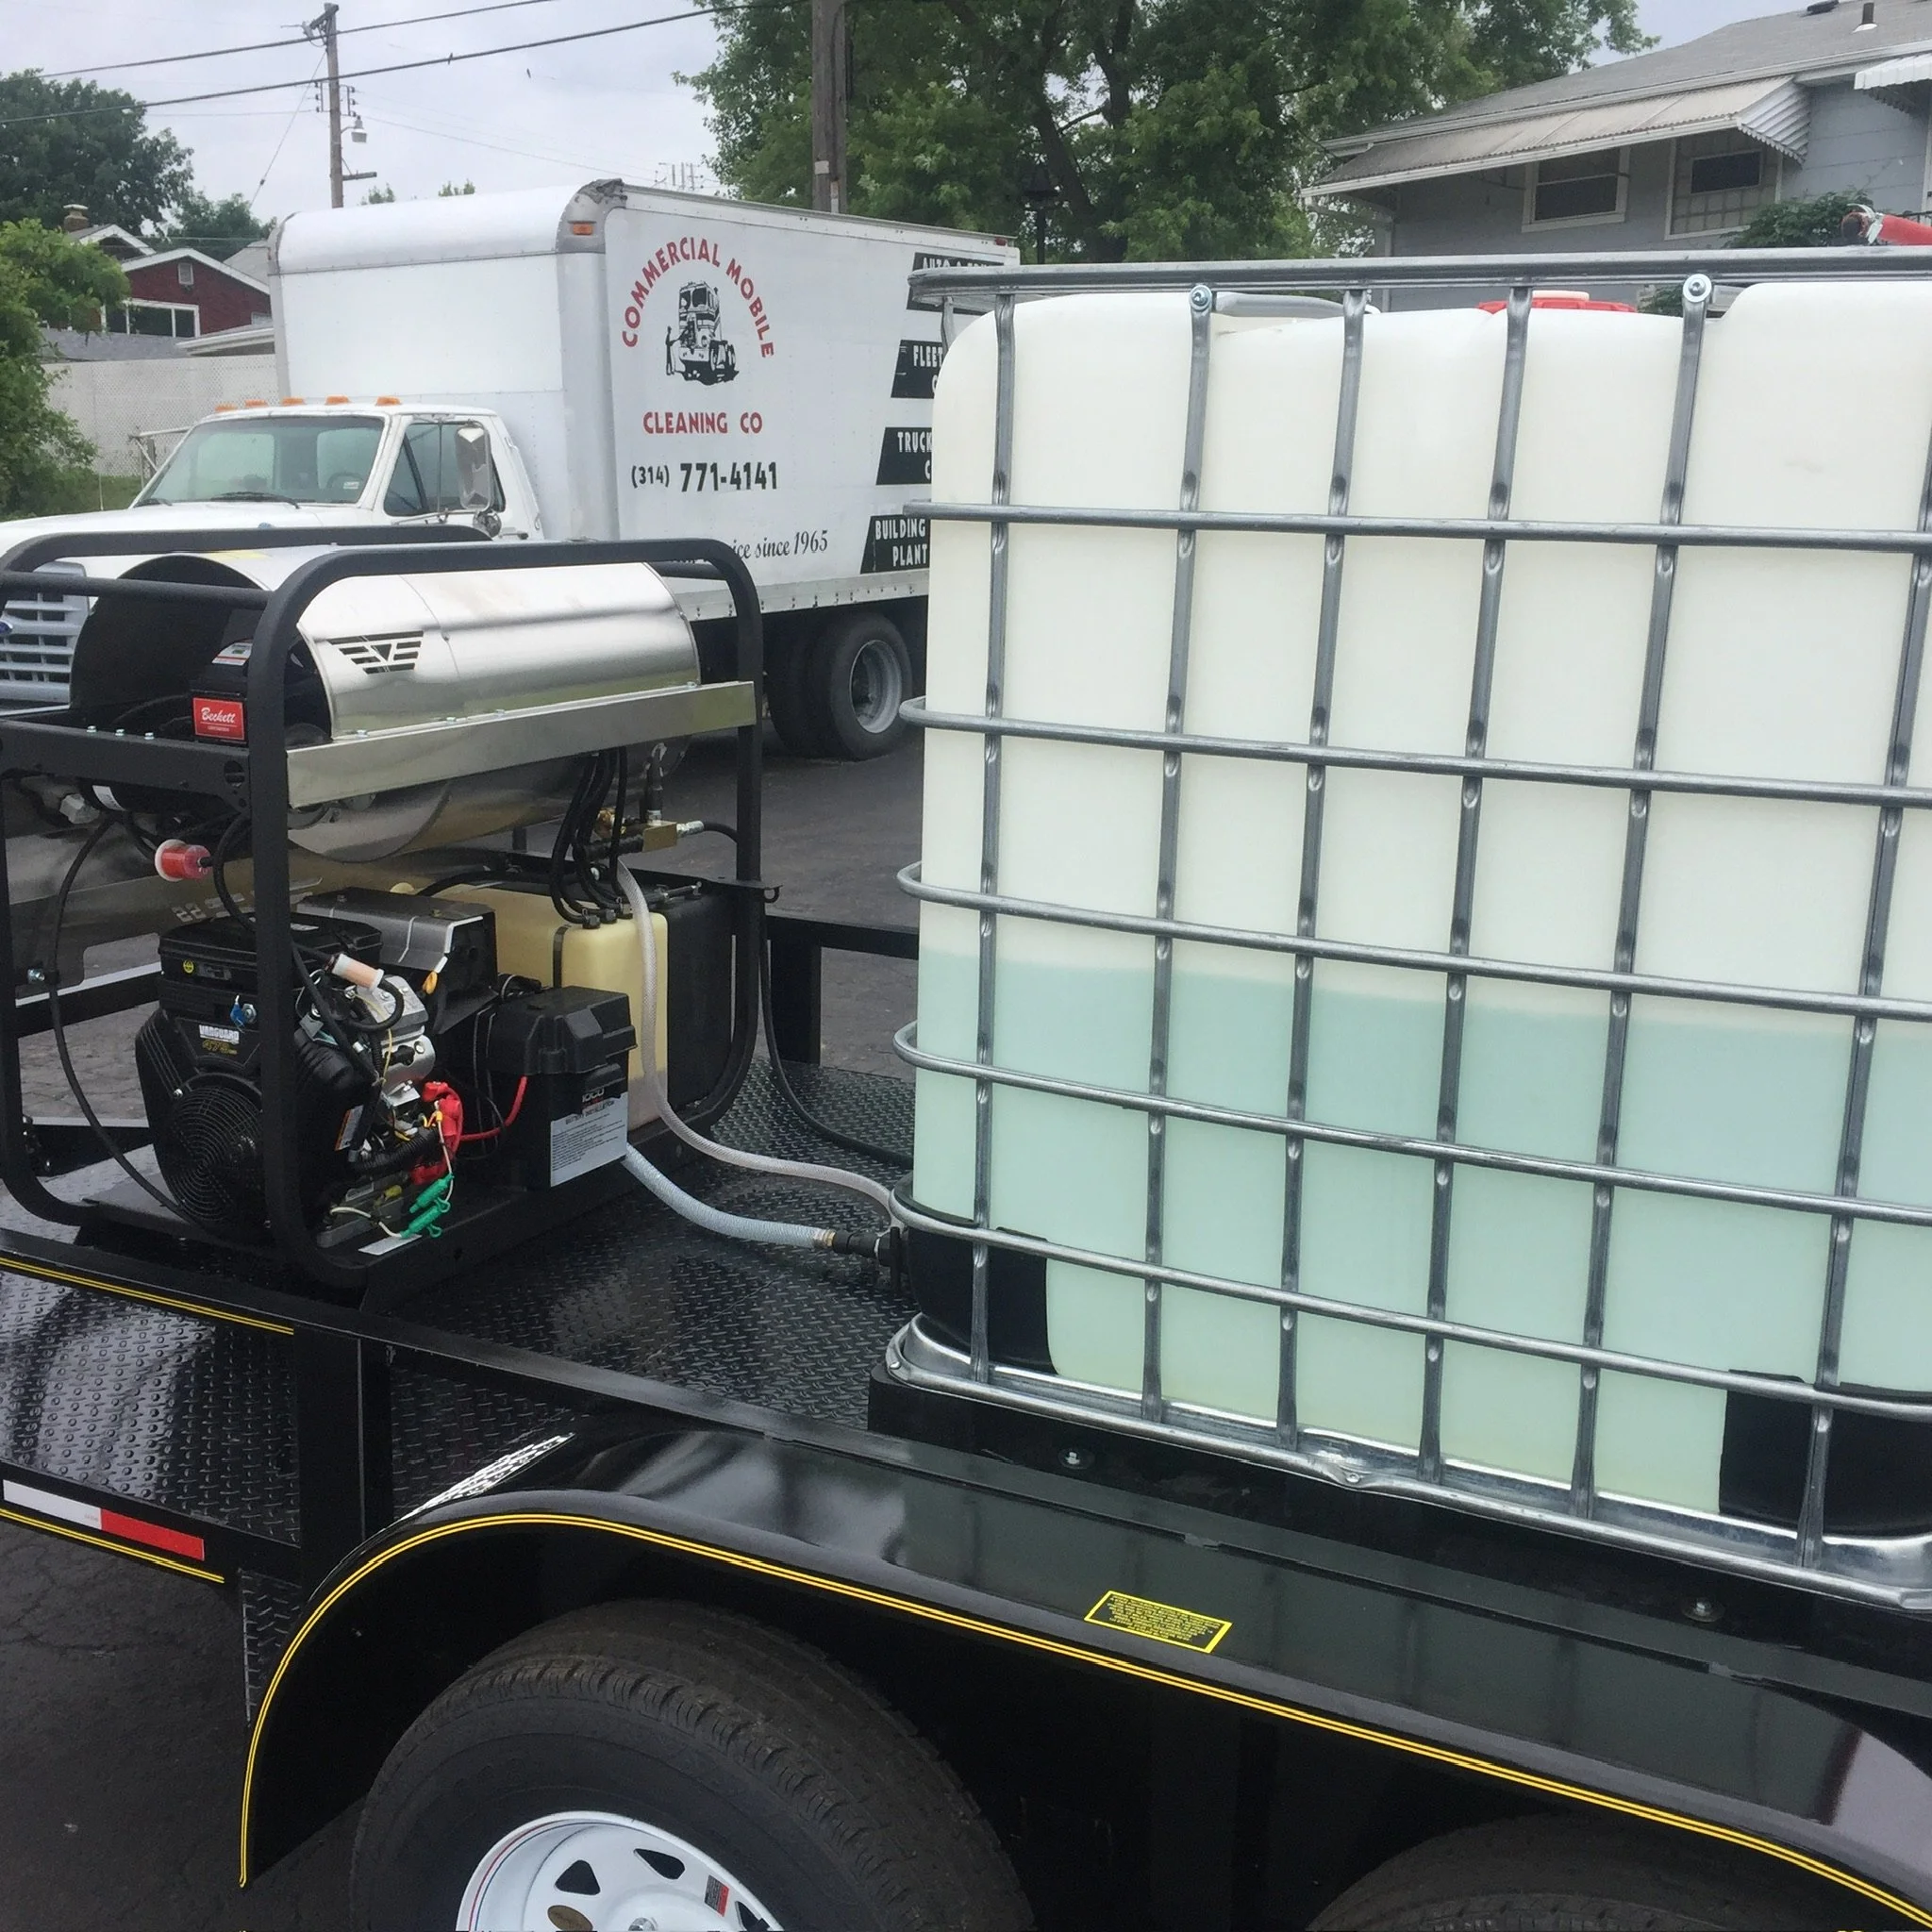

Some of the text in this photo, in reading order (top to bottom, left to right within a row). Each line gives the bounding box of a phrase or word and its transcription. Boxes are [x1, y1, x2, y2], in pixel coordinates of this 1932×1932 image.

[622, 237, 774, 358] COMMERCIAL MOBILE
[642, 411, 763, 434] CLEANING CO
[631, 461, 777, 492] (314) 771-4141
[874, 518, 925, 541] BUILDING
[755, 537, 791, 558] since
[793, 529, 828, 556] 1965
[892, 543, 928, 567] PLANT
[200, 707, 237, 724] Beckett
[199, 1024, 240, 1043] VANGUARD
